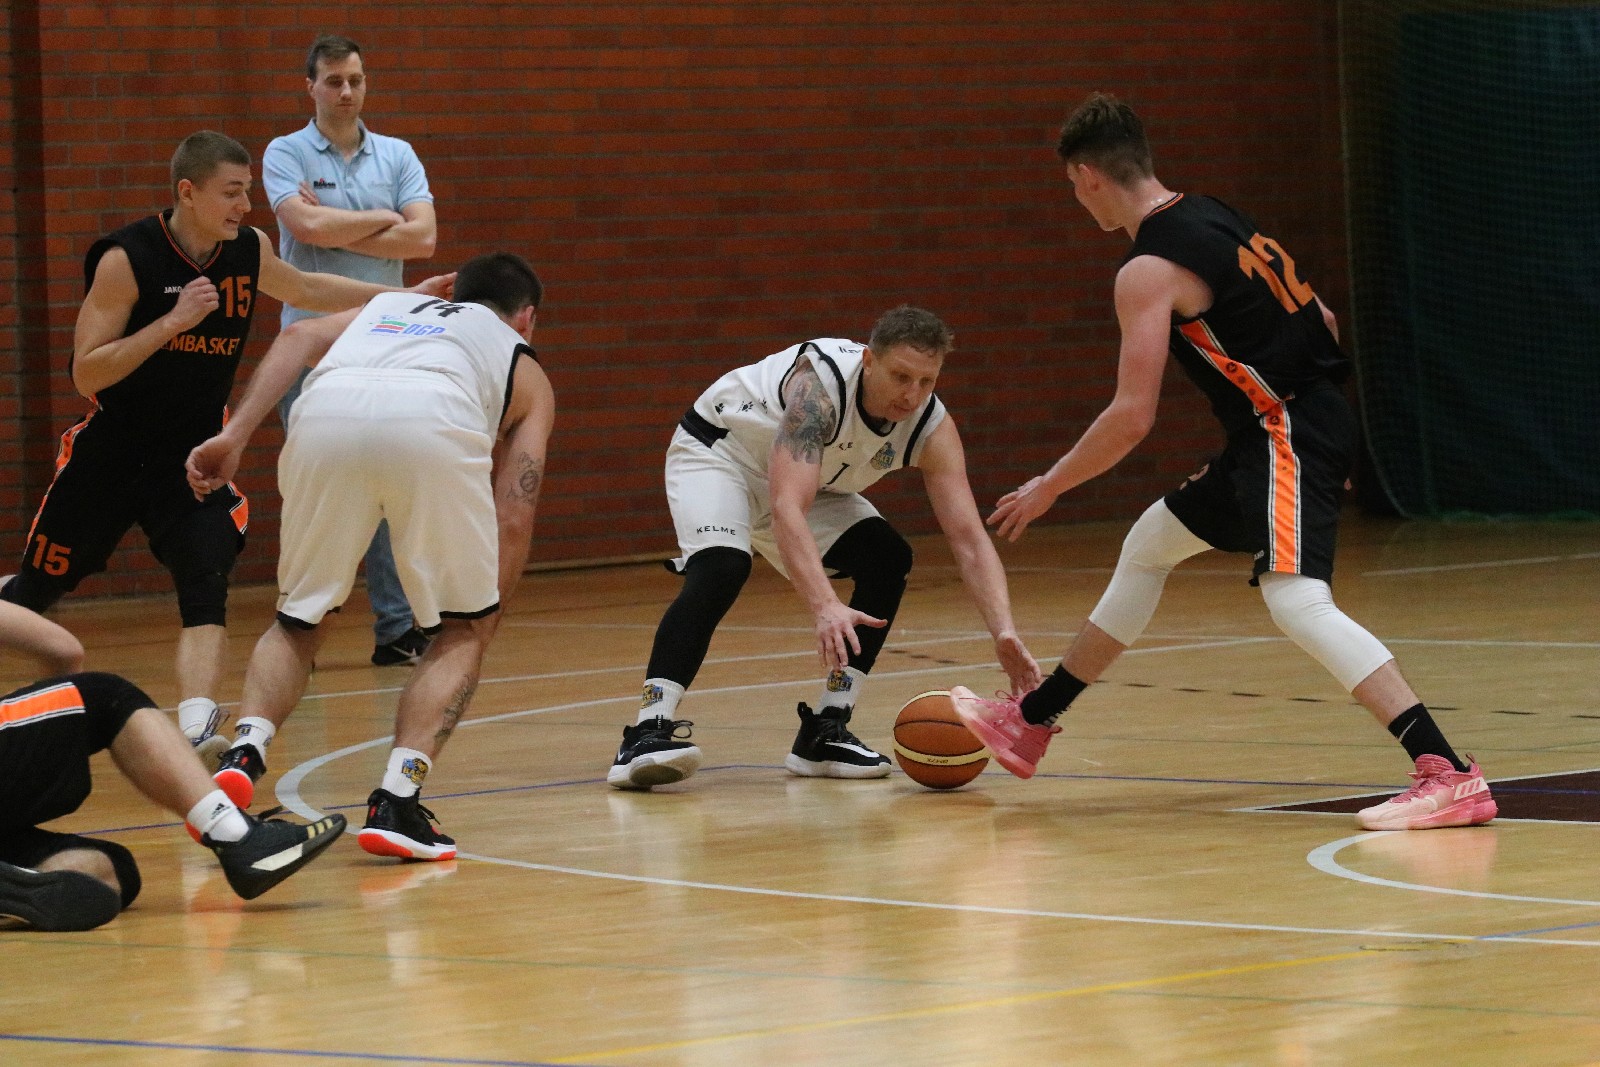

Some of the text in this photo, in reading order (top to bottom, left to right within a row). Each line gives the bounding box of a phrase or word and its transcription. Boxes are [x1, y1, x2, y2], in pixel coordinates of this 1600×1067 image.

[1238, 233, 1315, 314] 12
[220, 276, 252, 318] 15
[409, 299, 467, 318] 14
[696, 525, 737, 536] KELME
[32, 533, 72, 576] 15
